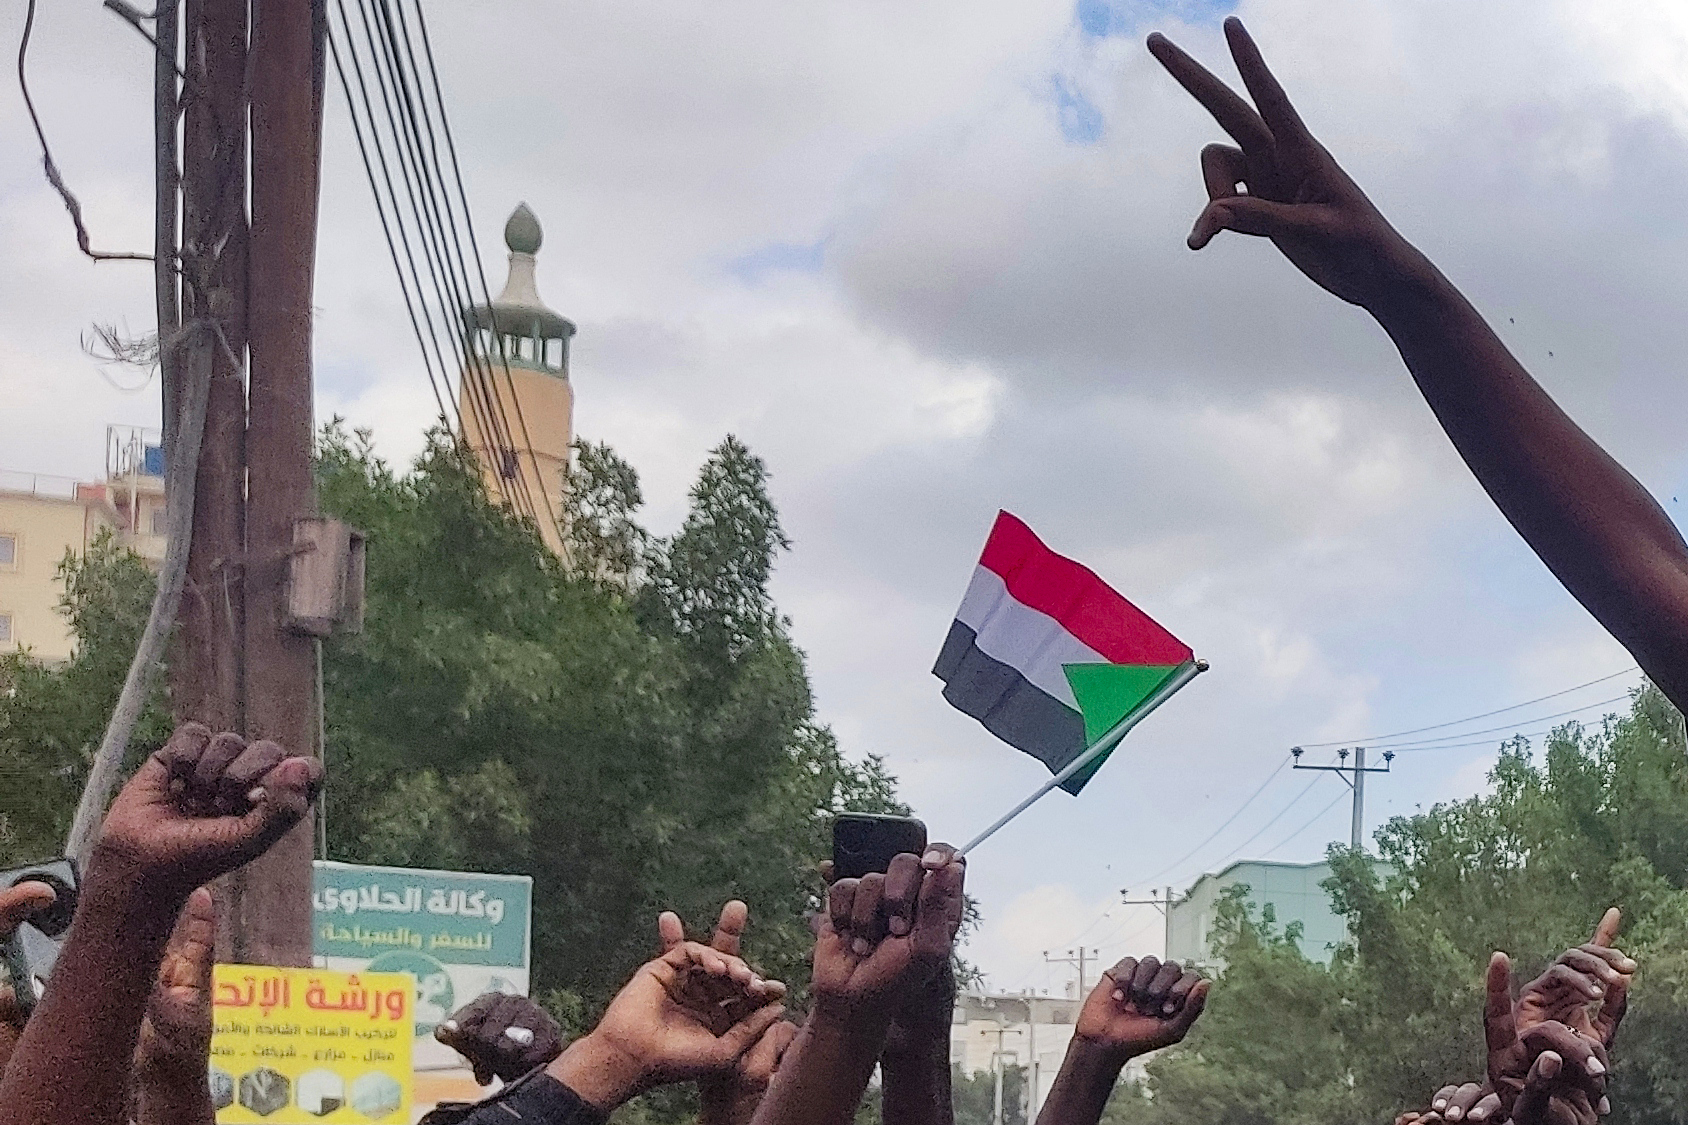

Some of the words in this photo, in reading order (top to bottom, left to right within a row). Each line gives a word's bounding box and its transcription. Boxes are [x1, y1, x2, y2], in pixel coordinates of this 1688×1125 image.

[426, 888, 505, 924] وكالة
[320, 923, 423, 949] والسياحة
[429, 930, 493, 951] للسفر
[212, 976, 290, 1017] الإتح
[305, 974, 405, 1021] ورشة
